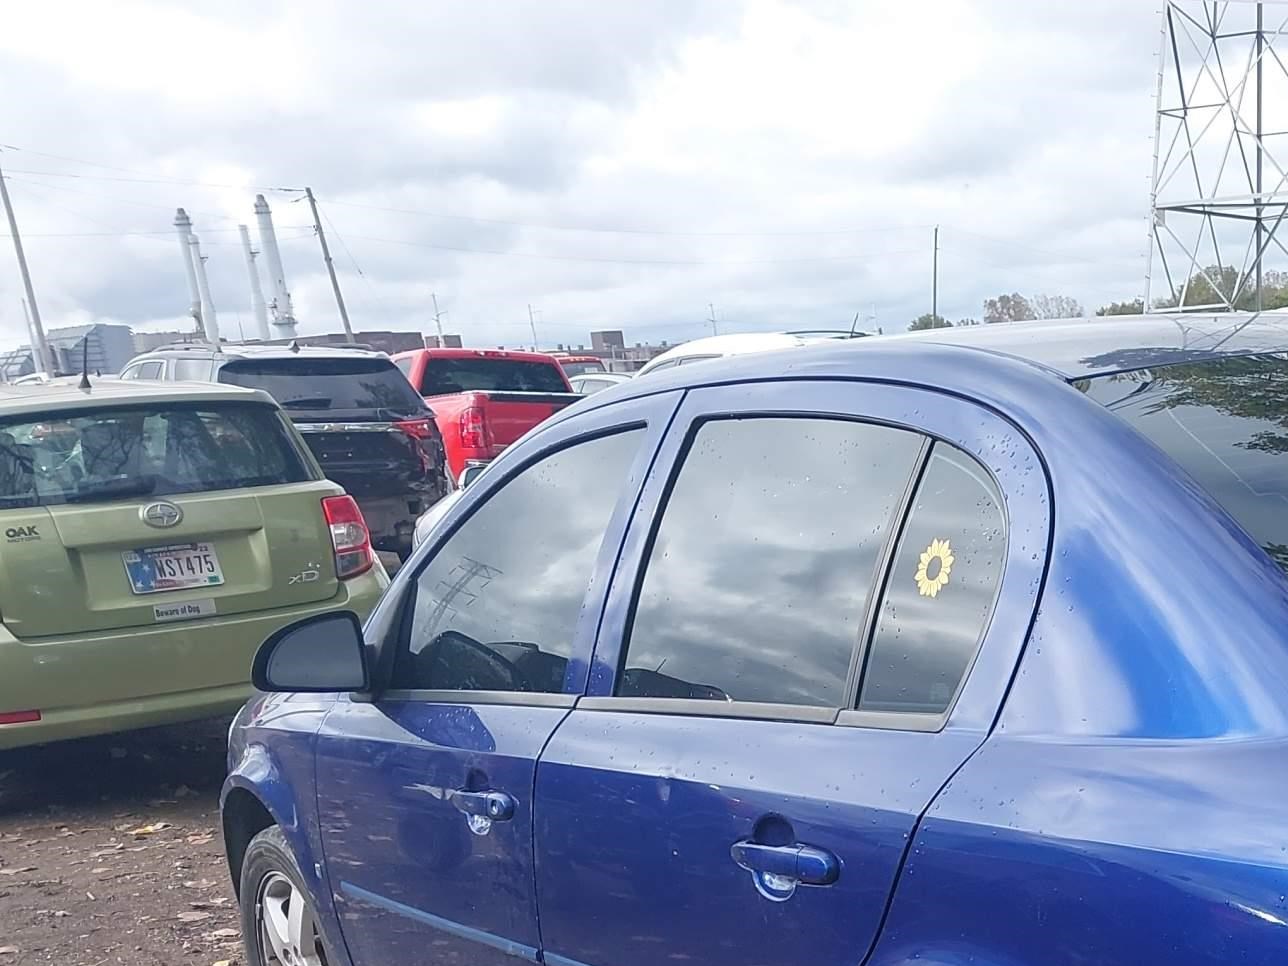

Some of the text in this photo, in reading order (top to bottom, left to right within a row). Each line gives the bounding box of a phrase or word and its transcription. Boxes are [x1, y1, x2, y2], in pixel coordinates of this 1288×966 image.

[5, 525, 40, 538] OAK
[155, 604, 201, 618] Beware of Dog
